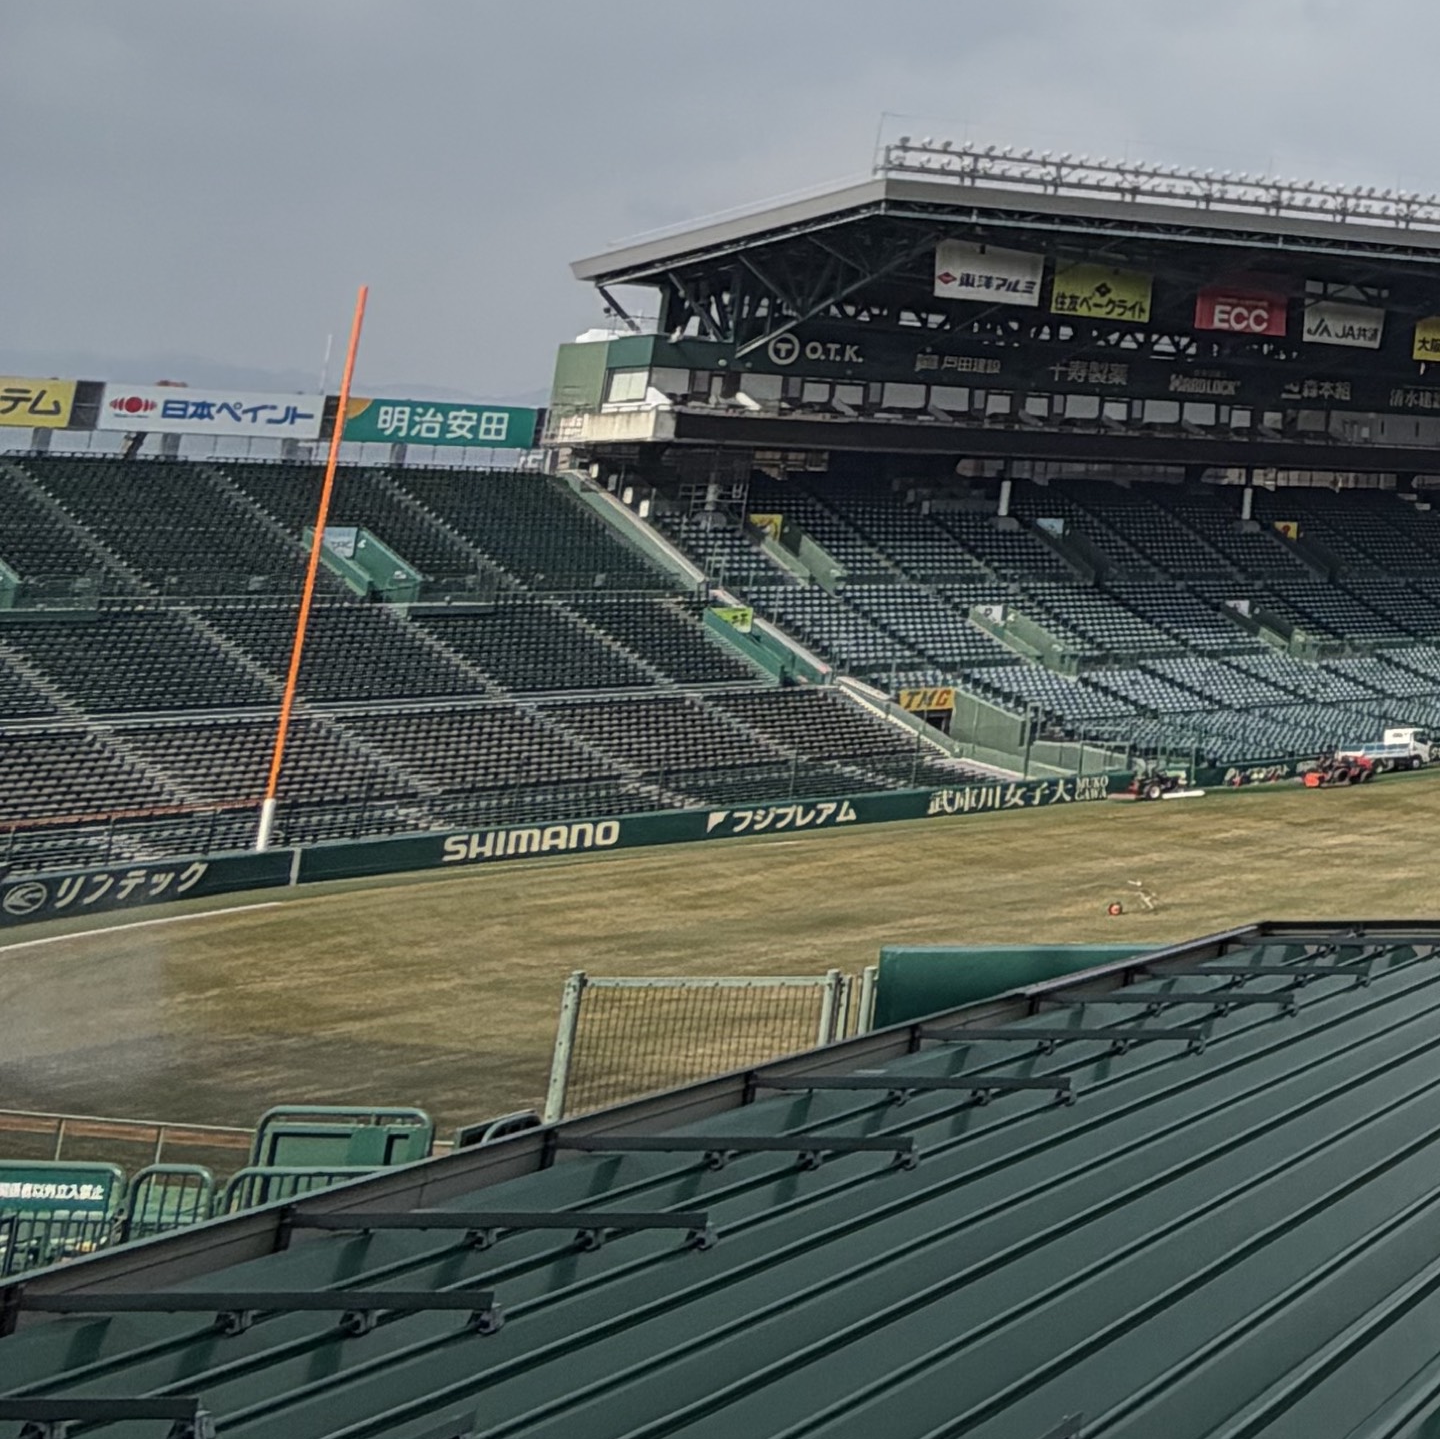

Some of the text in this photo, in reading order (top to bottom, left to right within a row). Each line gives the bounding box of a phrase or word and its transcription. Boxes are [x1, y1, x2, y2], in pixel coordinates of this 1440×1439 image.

[958, 272, 1037, 295] 東洋アルミ
[1054, 292, 1146, 320] 住友ベークライト
[1213, 305, 1269, 333] ECC
[804, 341, 864, 363] O.T.K.
[941, 355, 1000, 375] 戸田建設
[0, 386, 62, 417] テム
[1301, 378, 1352, 403] 森本組
[161, 398, 314, 426] 日本ペイント
[377, 404, 510, 441] 明治安田
[903, 687, 953, 711] TMG
[926, 779, 1073, 816] 武庫川女子大
[732, 800, 857, 833] フジプレアム
[442, 820, 620, 862] SHIMANO
[53, 861, 209, 909] リンテック
